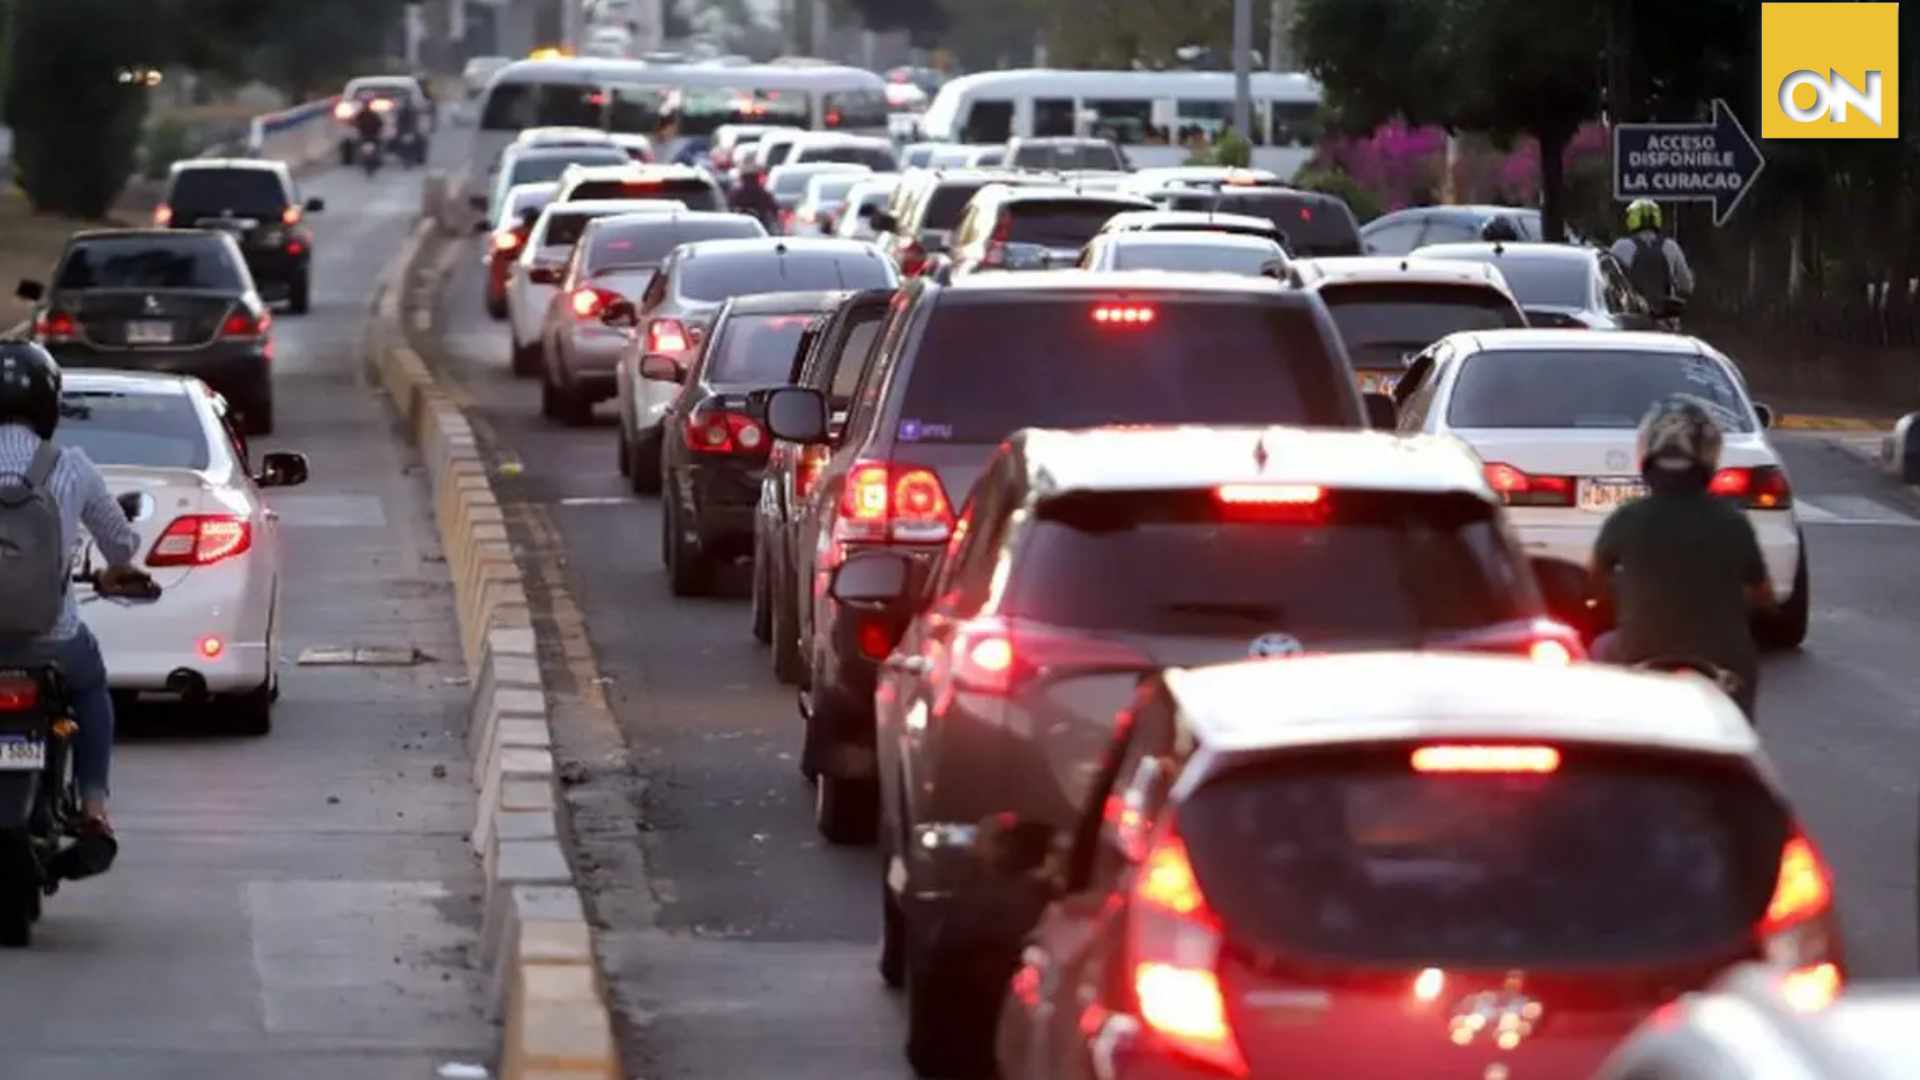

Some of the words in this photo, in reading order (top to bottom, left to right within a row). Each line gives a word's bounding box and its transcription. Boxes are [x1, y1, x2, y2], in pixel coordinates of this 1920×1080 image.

[1647, 135, 1716, 150] ACCESO
[1628, 151, 1735, 167] DISPONIBLE
[1623, 173, 1649, 189] LA
[1652, 173, 1742, 189] CURACAO
